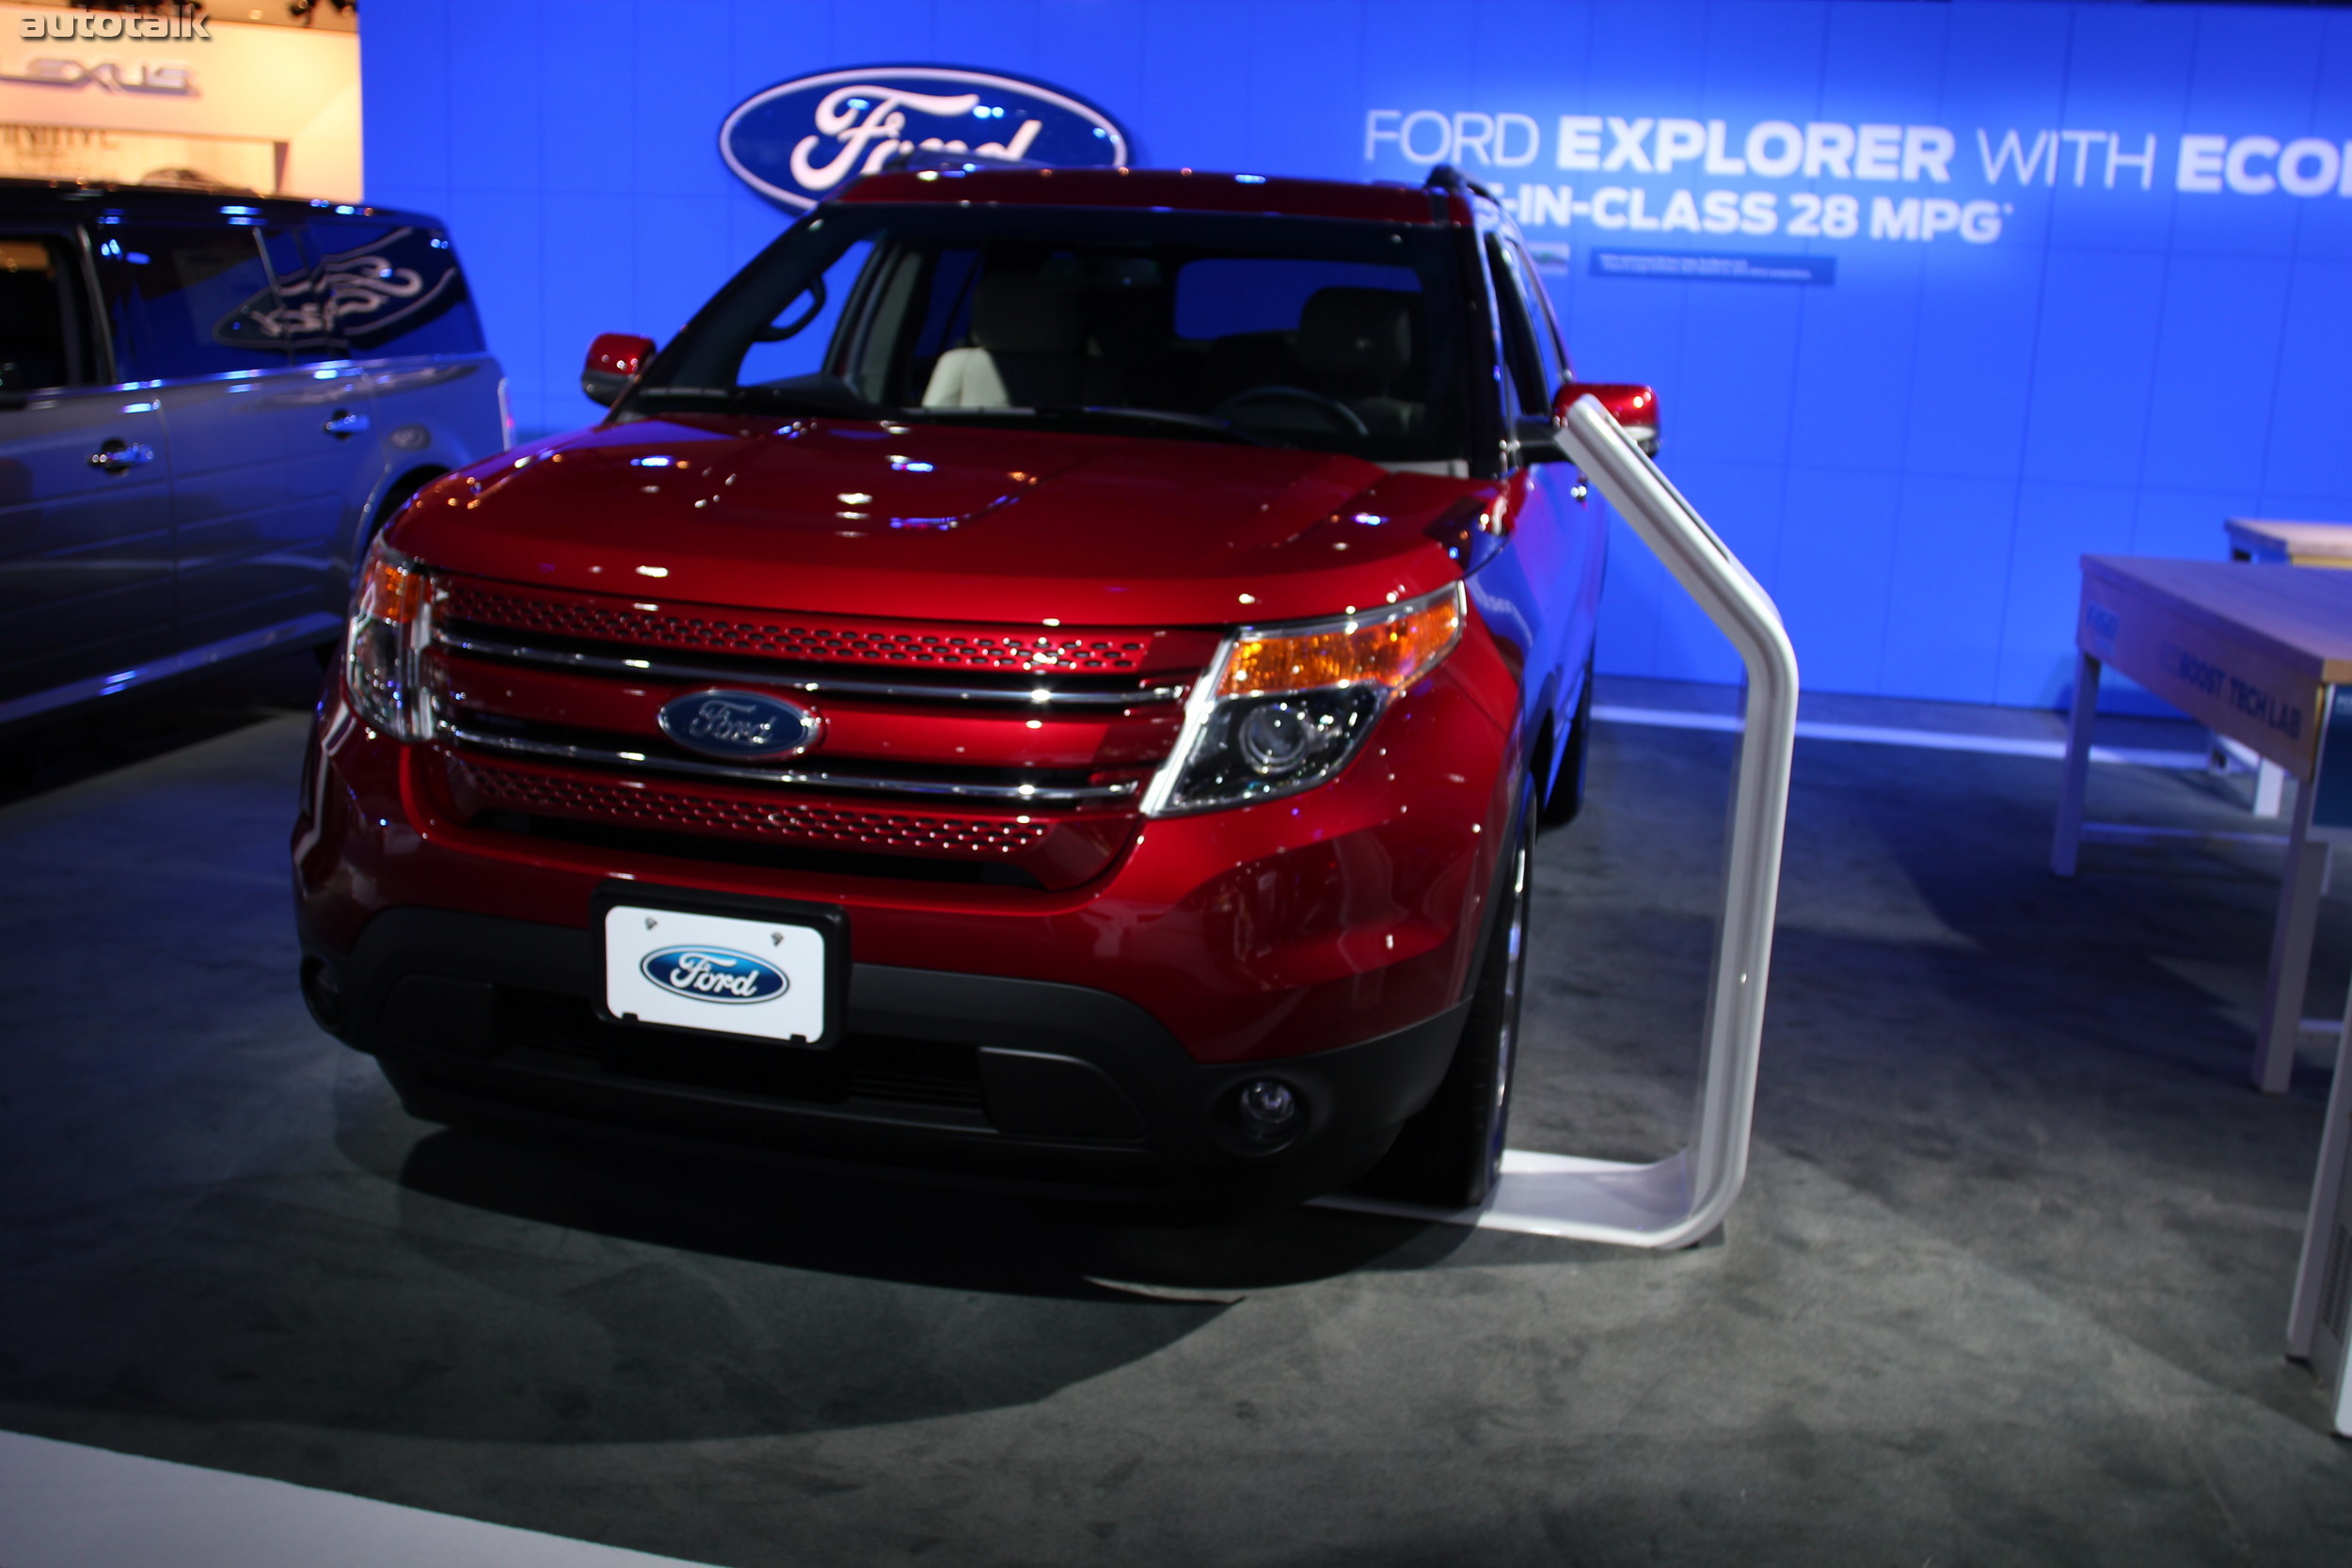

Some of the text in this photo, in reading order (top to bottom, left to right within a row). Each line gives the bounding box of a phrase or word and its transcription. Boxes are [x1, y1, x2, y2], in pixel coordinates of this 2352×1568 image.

[790, 85, 1041, 190] Fod
[1365, 109, 2352, 198] FORD EXPLORER WITH ECO
[1788, 192, 1859, 238] 28
[689, 700, 778, 744] Ford
[2268, 696, 2301, 739] LAB
[670, 953, 759, 997] Ford
